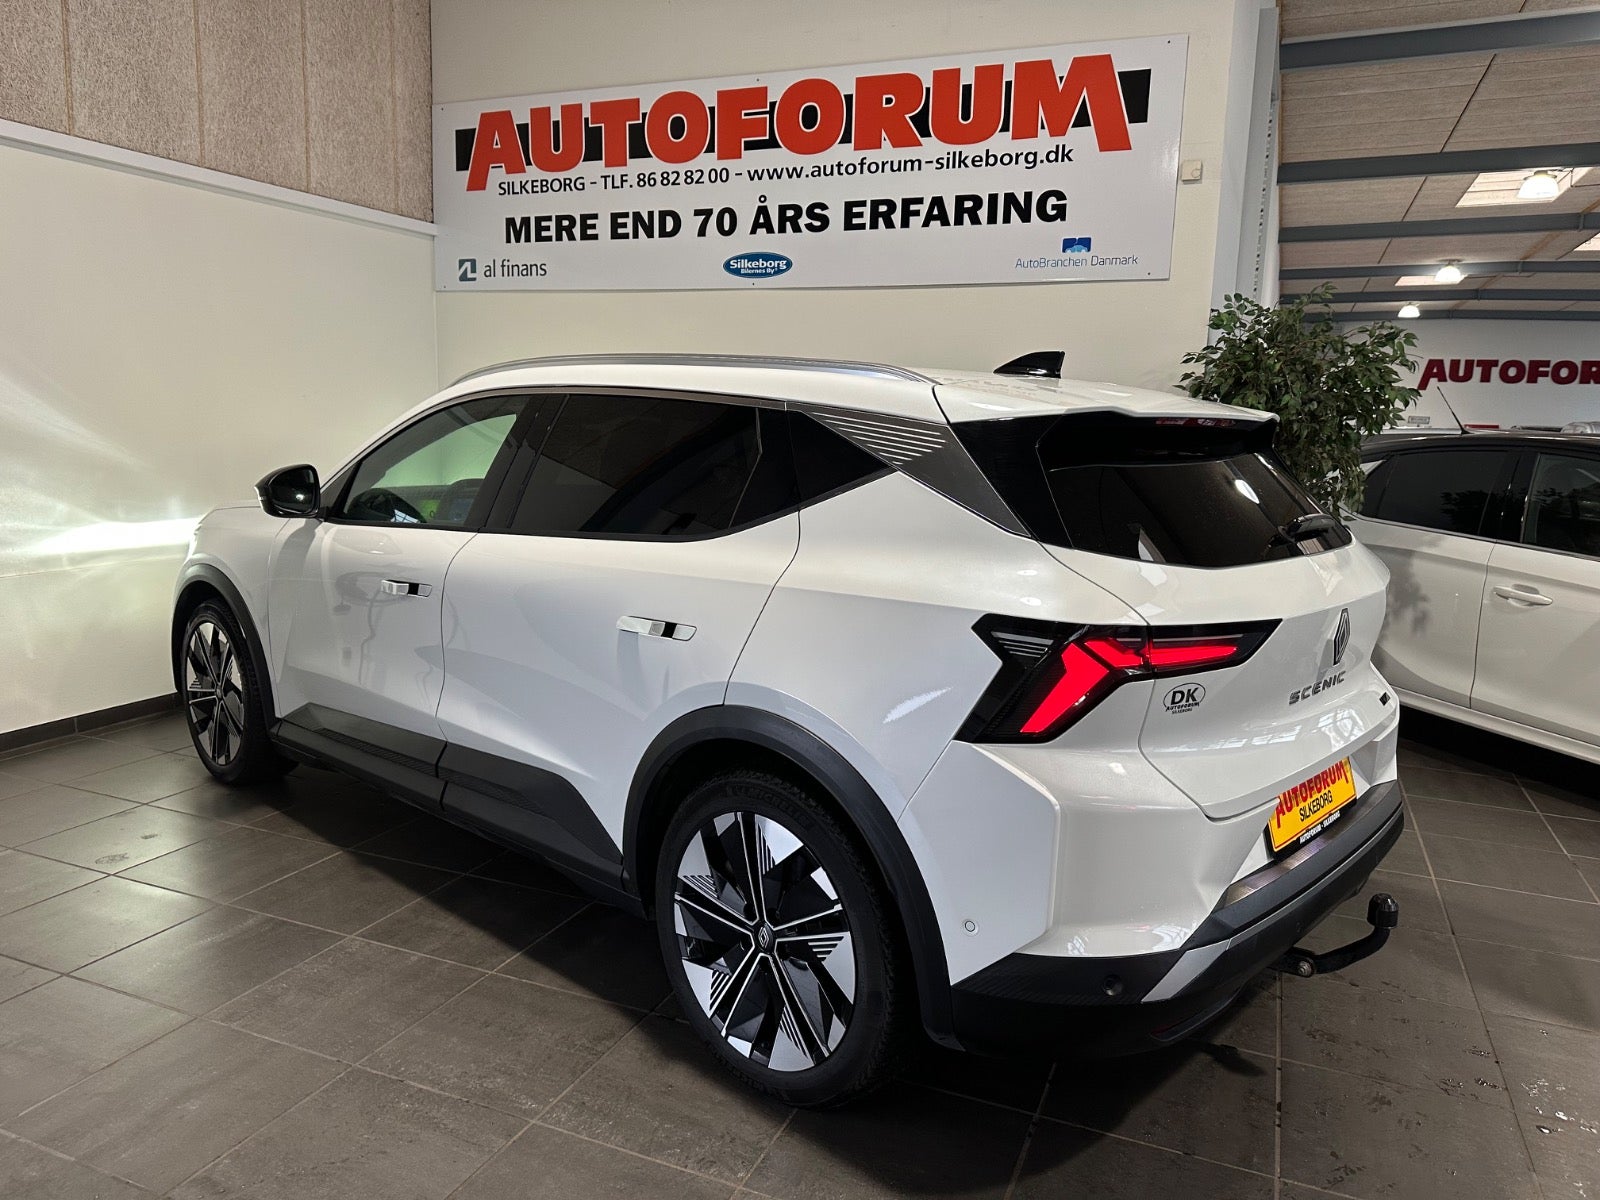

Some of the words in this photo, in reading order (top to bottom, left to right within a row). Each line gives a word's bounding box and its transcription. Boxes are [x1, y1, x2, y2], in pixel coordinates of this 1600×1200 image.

[466, 54, 1132, 191] AUTOFORUM
[498, 177, 585, 196] SILKEBORG
[600, 174, 633, 189] TLF.
[636, 172, 657, 188] 86
[660, 171, 681, 186] 82
[684, 169, 705, 185] 82
[708, 168, 730, 183] 00
[747, 144, 1074, 181] www.autoforum-silkeborg.dk
[504, 213, 599, 244] MERE
[609, 209, 682, 240] END
[693, 206, 738, 238] 70
[749, 194, 830, 235] ÅRS
[843, 189, 1068, 231] ERFARING
[483, 259, 496, 278] al
[501, 259, 547, 277] finans
[729, 258, 788, 270] Silkeborg
[1015, 257, 1087, 269] AutoBranchen
[1090, 255, 1139, 267] Danmark
[1170, 687, 1199, 705] DK
[1289, 670, 1346, 705] SCENIC
[1275, 760, 1349, 829] AUTOFORUM
[1299, 790, 1333, 822] SILKEBORG
